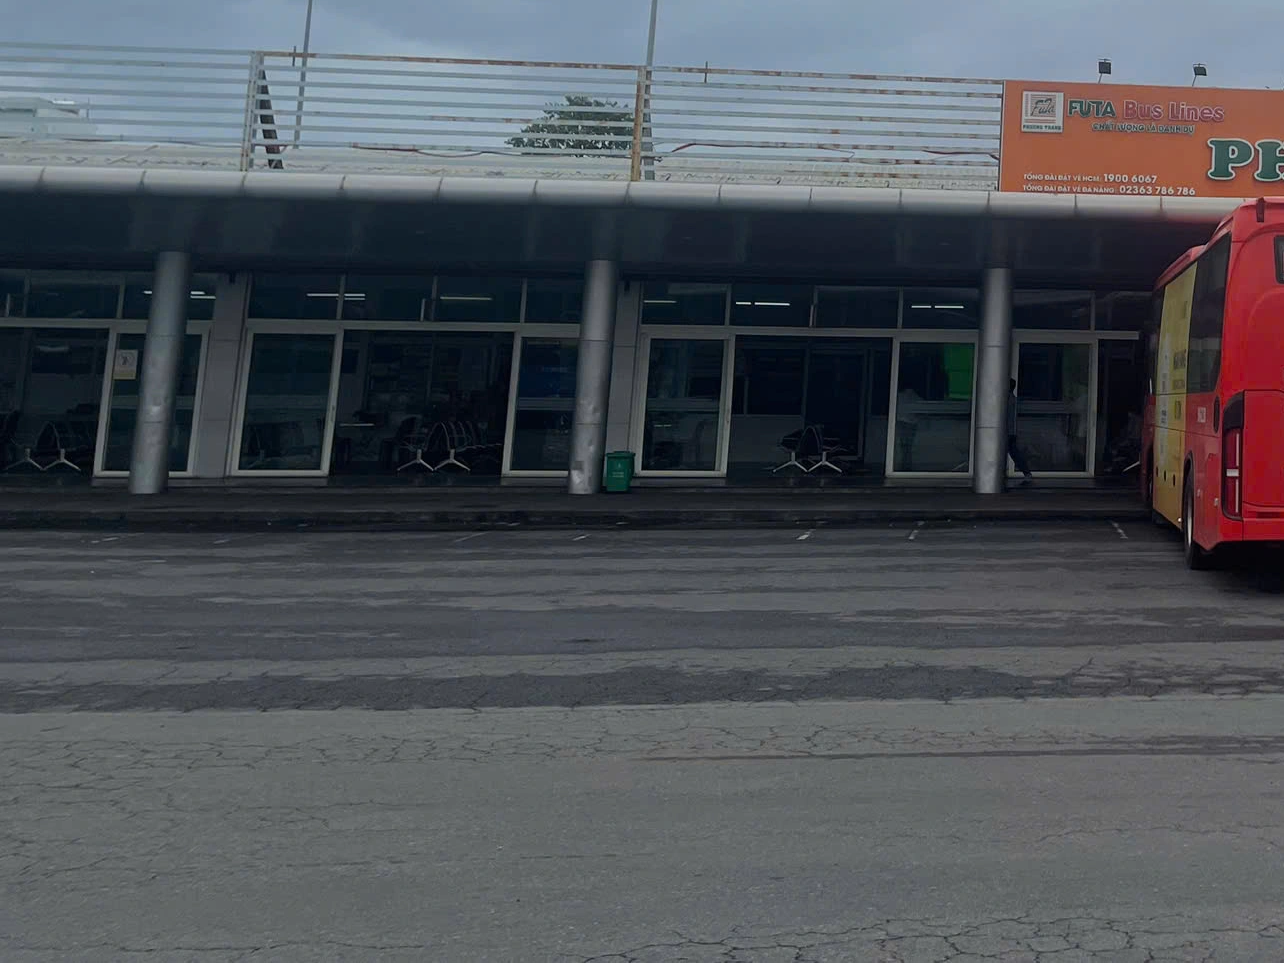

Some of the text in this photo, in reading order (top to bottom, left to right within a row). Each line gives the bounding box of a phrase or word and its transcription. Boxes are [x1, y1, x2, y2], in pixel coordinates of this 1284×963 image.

[1067, 99, 1225, 123] FUTA Bus Lines
[1103, 173, 1128, 183] 1900
[1131, 174, 1158, 184] 6067
[1119, 186, 1153, 195] 02363
[1155, 186, 1175, 196] 786
[1176, 187, 1196, 196] 786
